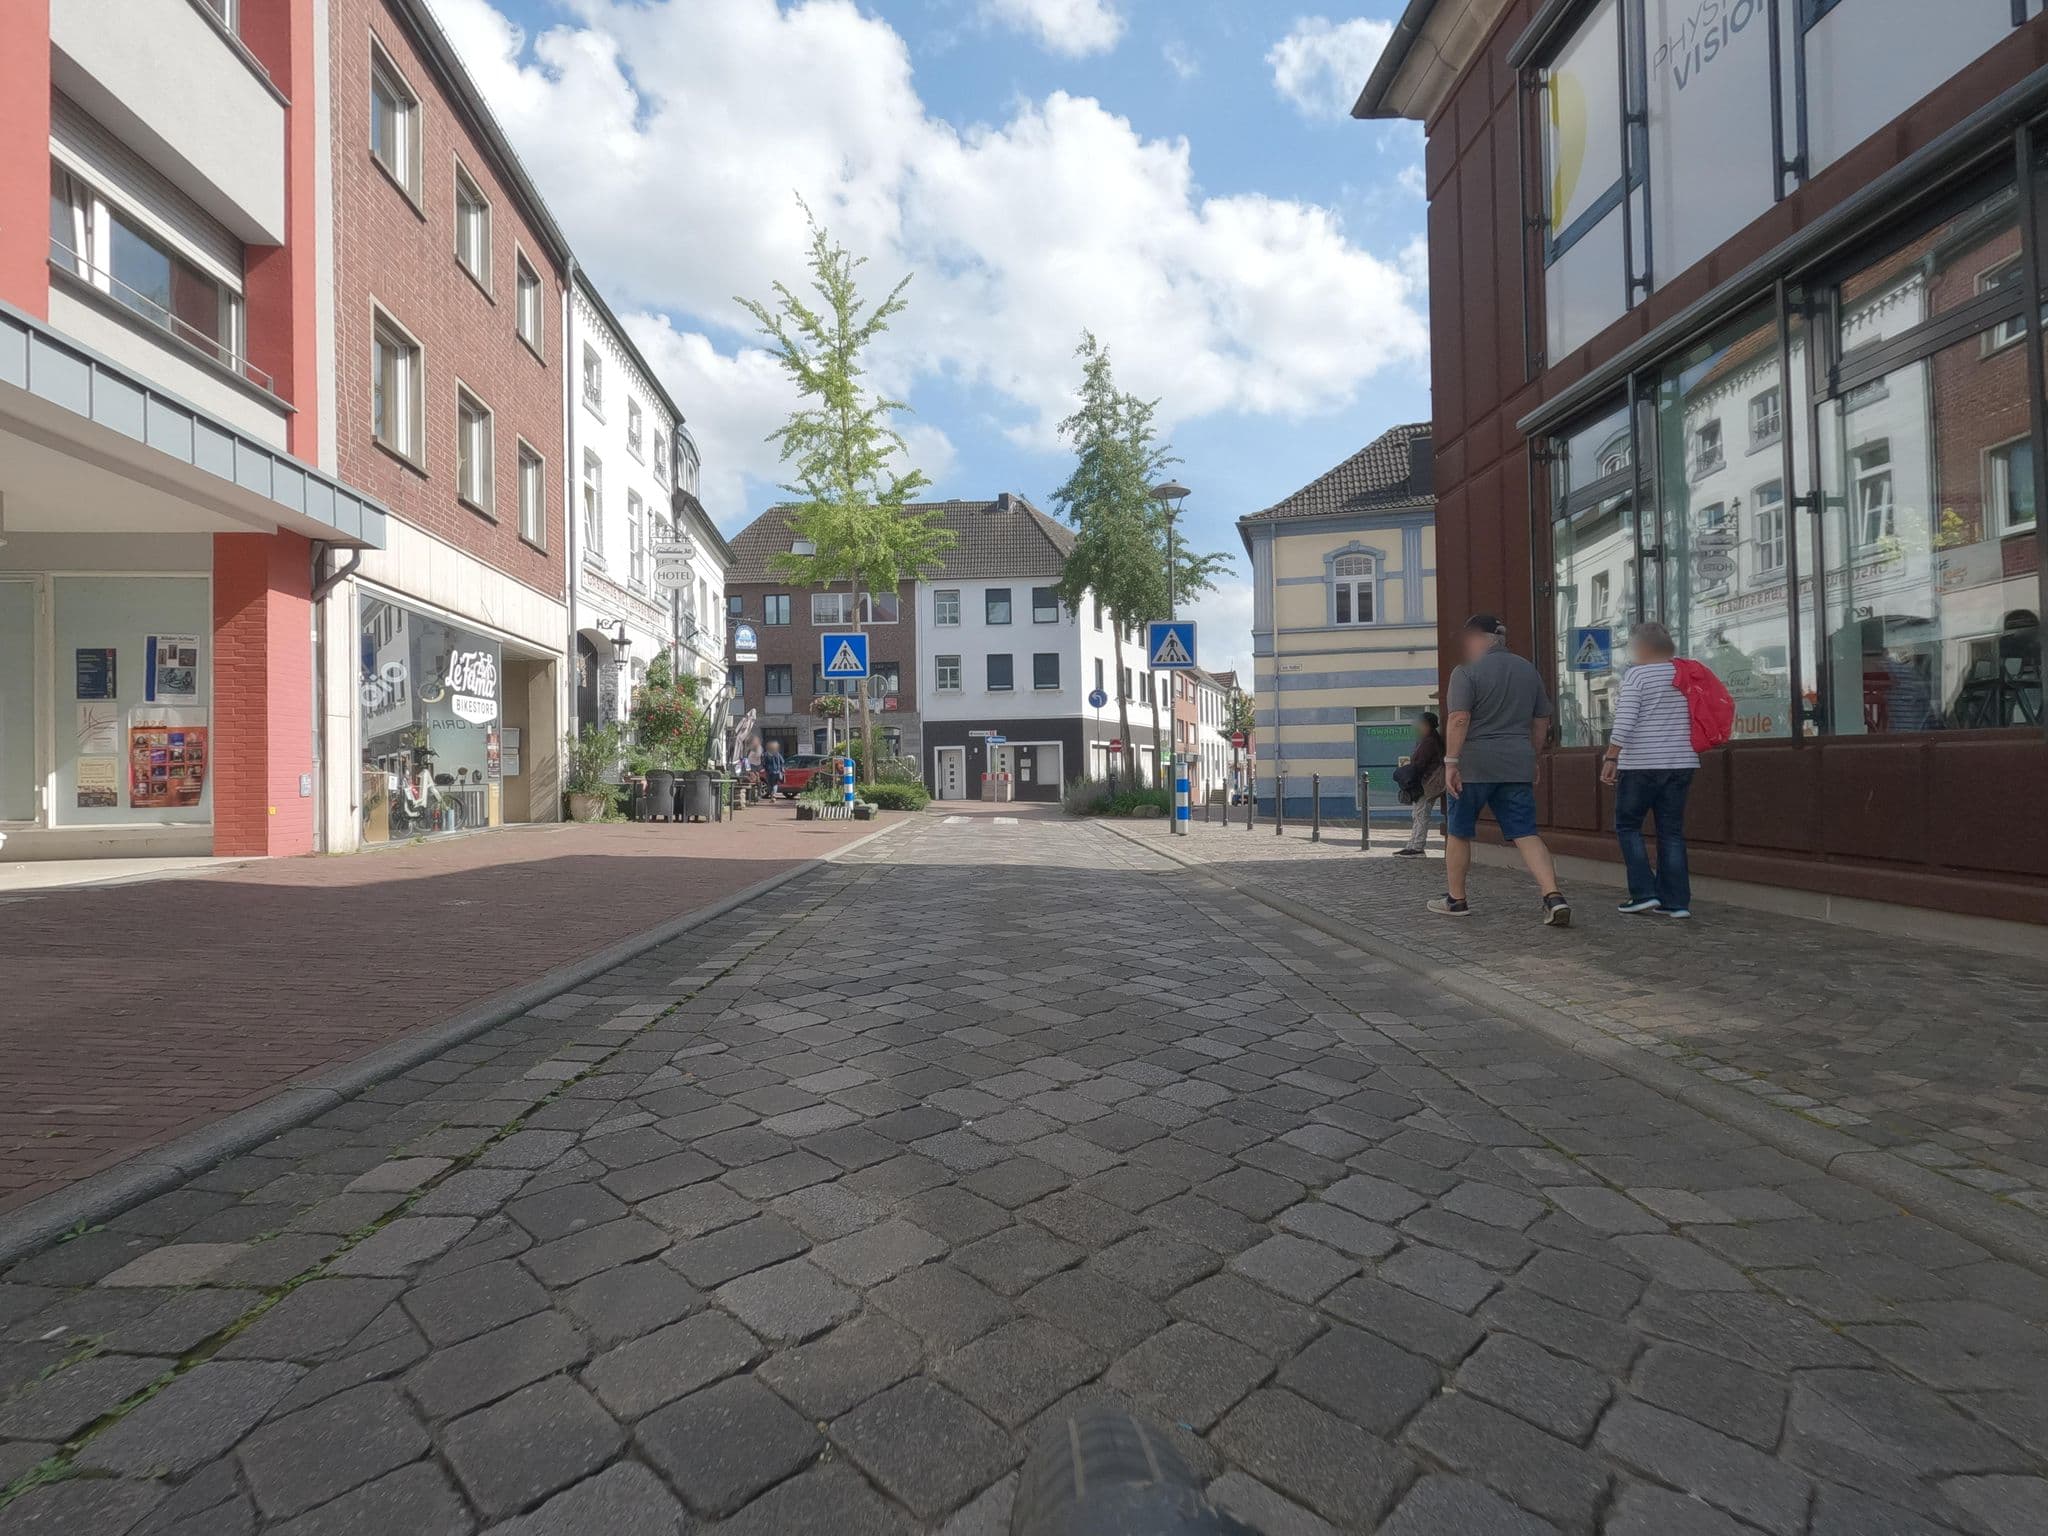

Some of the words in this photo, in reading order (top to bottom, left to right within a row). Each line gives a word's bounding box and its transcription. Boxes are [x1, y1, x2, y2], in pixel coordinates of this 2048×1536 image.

[657, 571, 692, 580] HOTEL
[456, 699, 494, 716] BIKESTORE
[1735, 712, 1773, 733] hule
